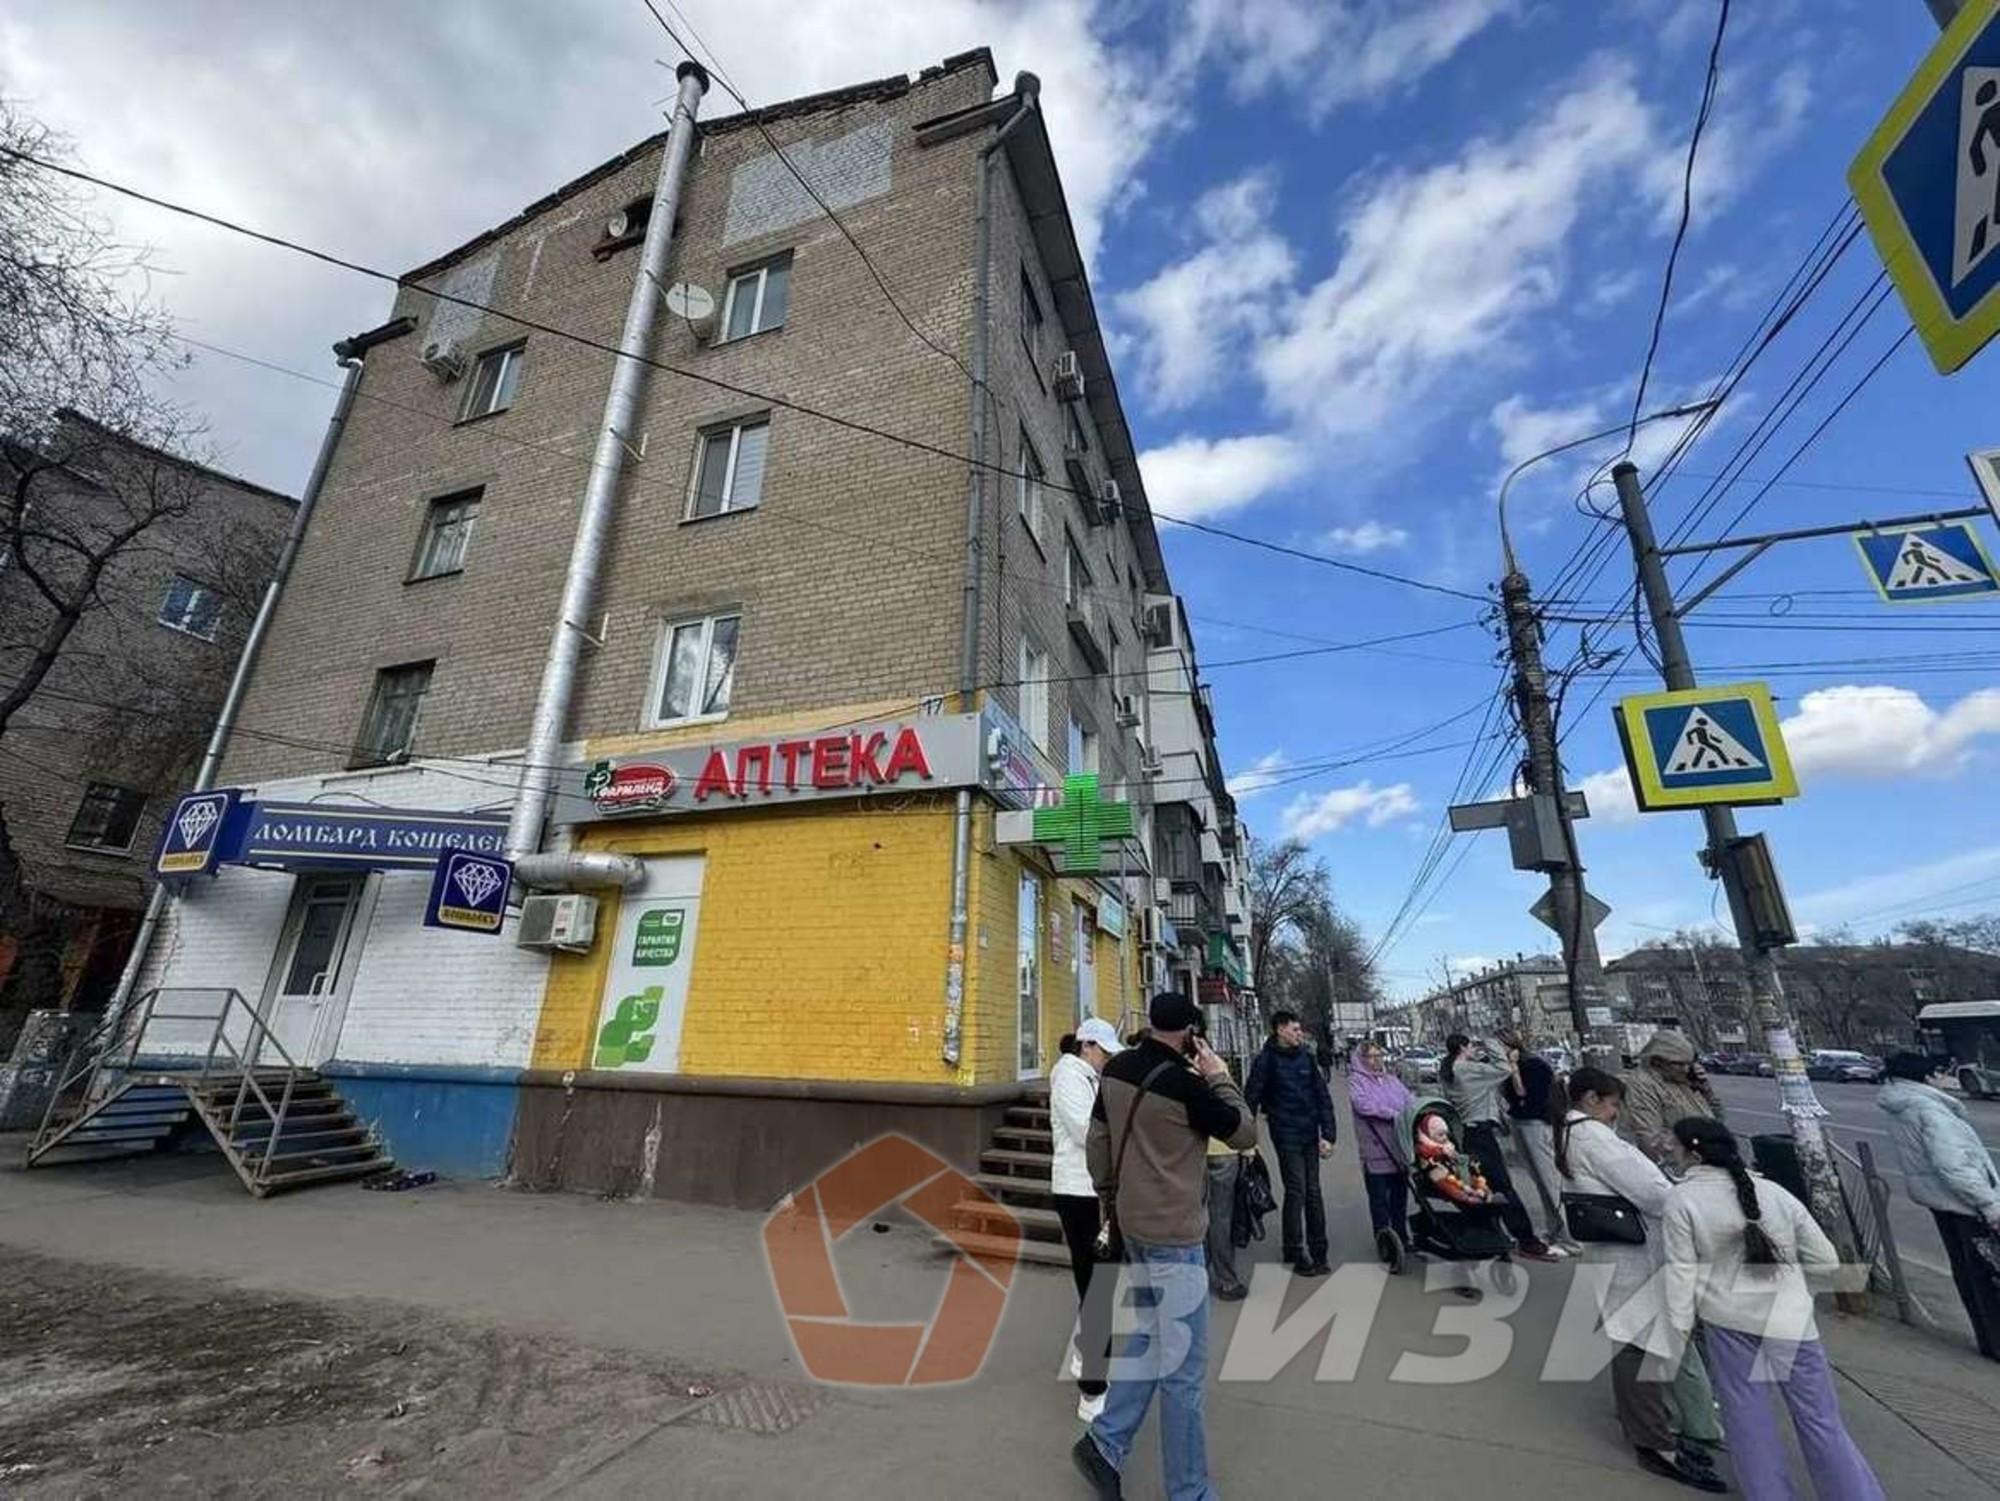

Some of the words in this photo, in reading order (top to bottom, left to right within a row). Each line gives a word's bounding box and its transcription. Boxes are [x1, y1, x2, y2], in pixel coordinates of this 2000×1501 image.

[922, 698, 943, 715] 17
[693, 727, 933, 802] АПТЕКА
[254, 823, 377, 848] ЛОМБАРД
